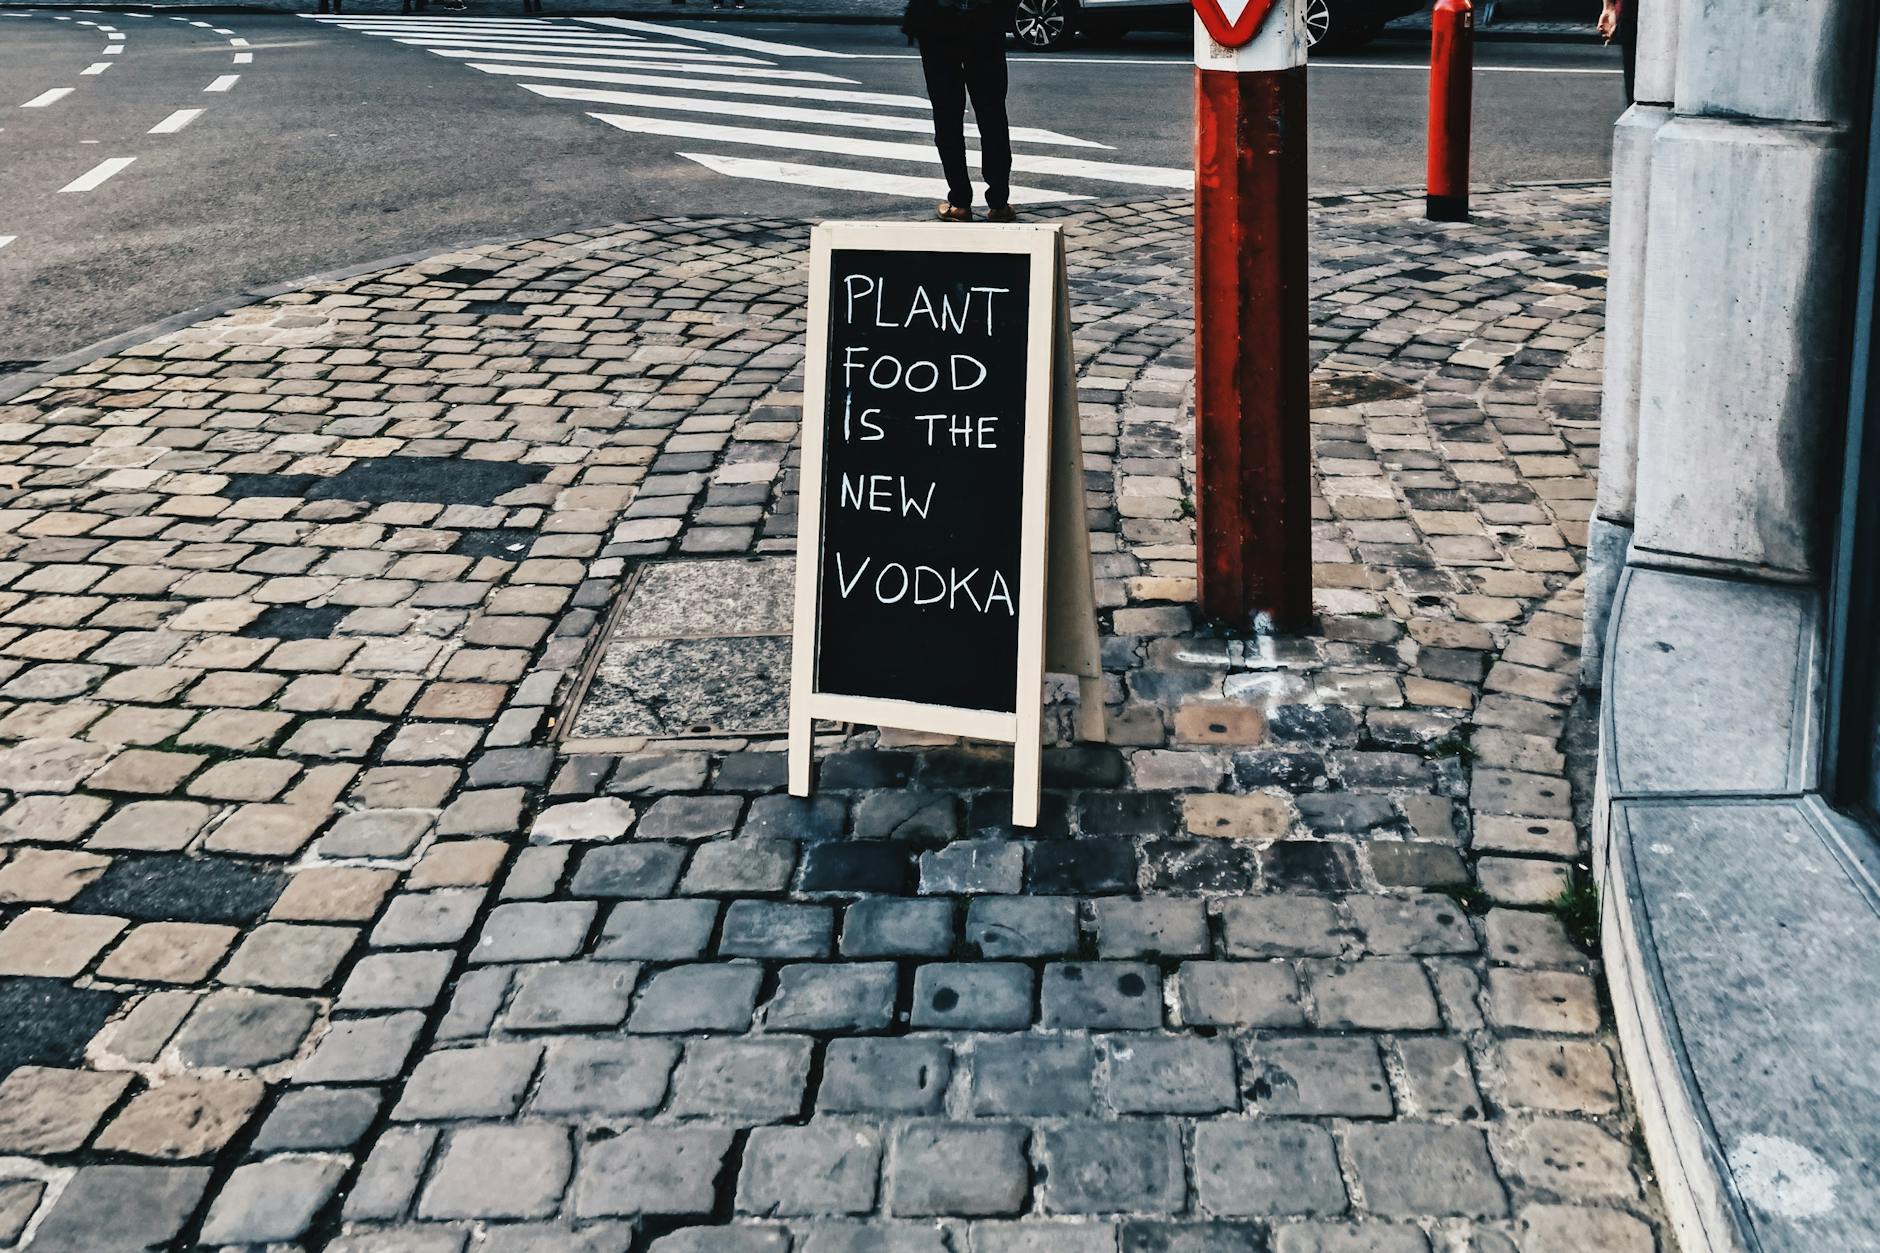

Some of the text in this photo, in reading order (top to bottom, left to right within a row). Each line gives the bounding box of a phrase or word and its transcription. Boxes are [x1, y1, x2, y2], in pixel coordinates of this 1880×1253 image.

[843, 273, 1011, 338] PLANT
[842, 345, 988, 393] FOOD
[842, 390, 999, 449] IS THE
[840, 471, 937, 520] NEW
[835, 551, 1016, 617] VODKA
